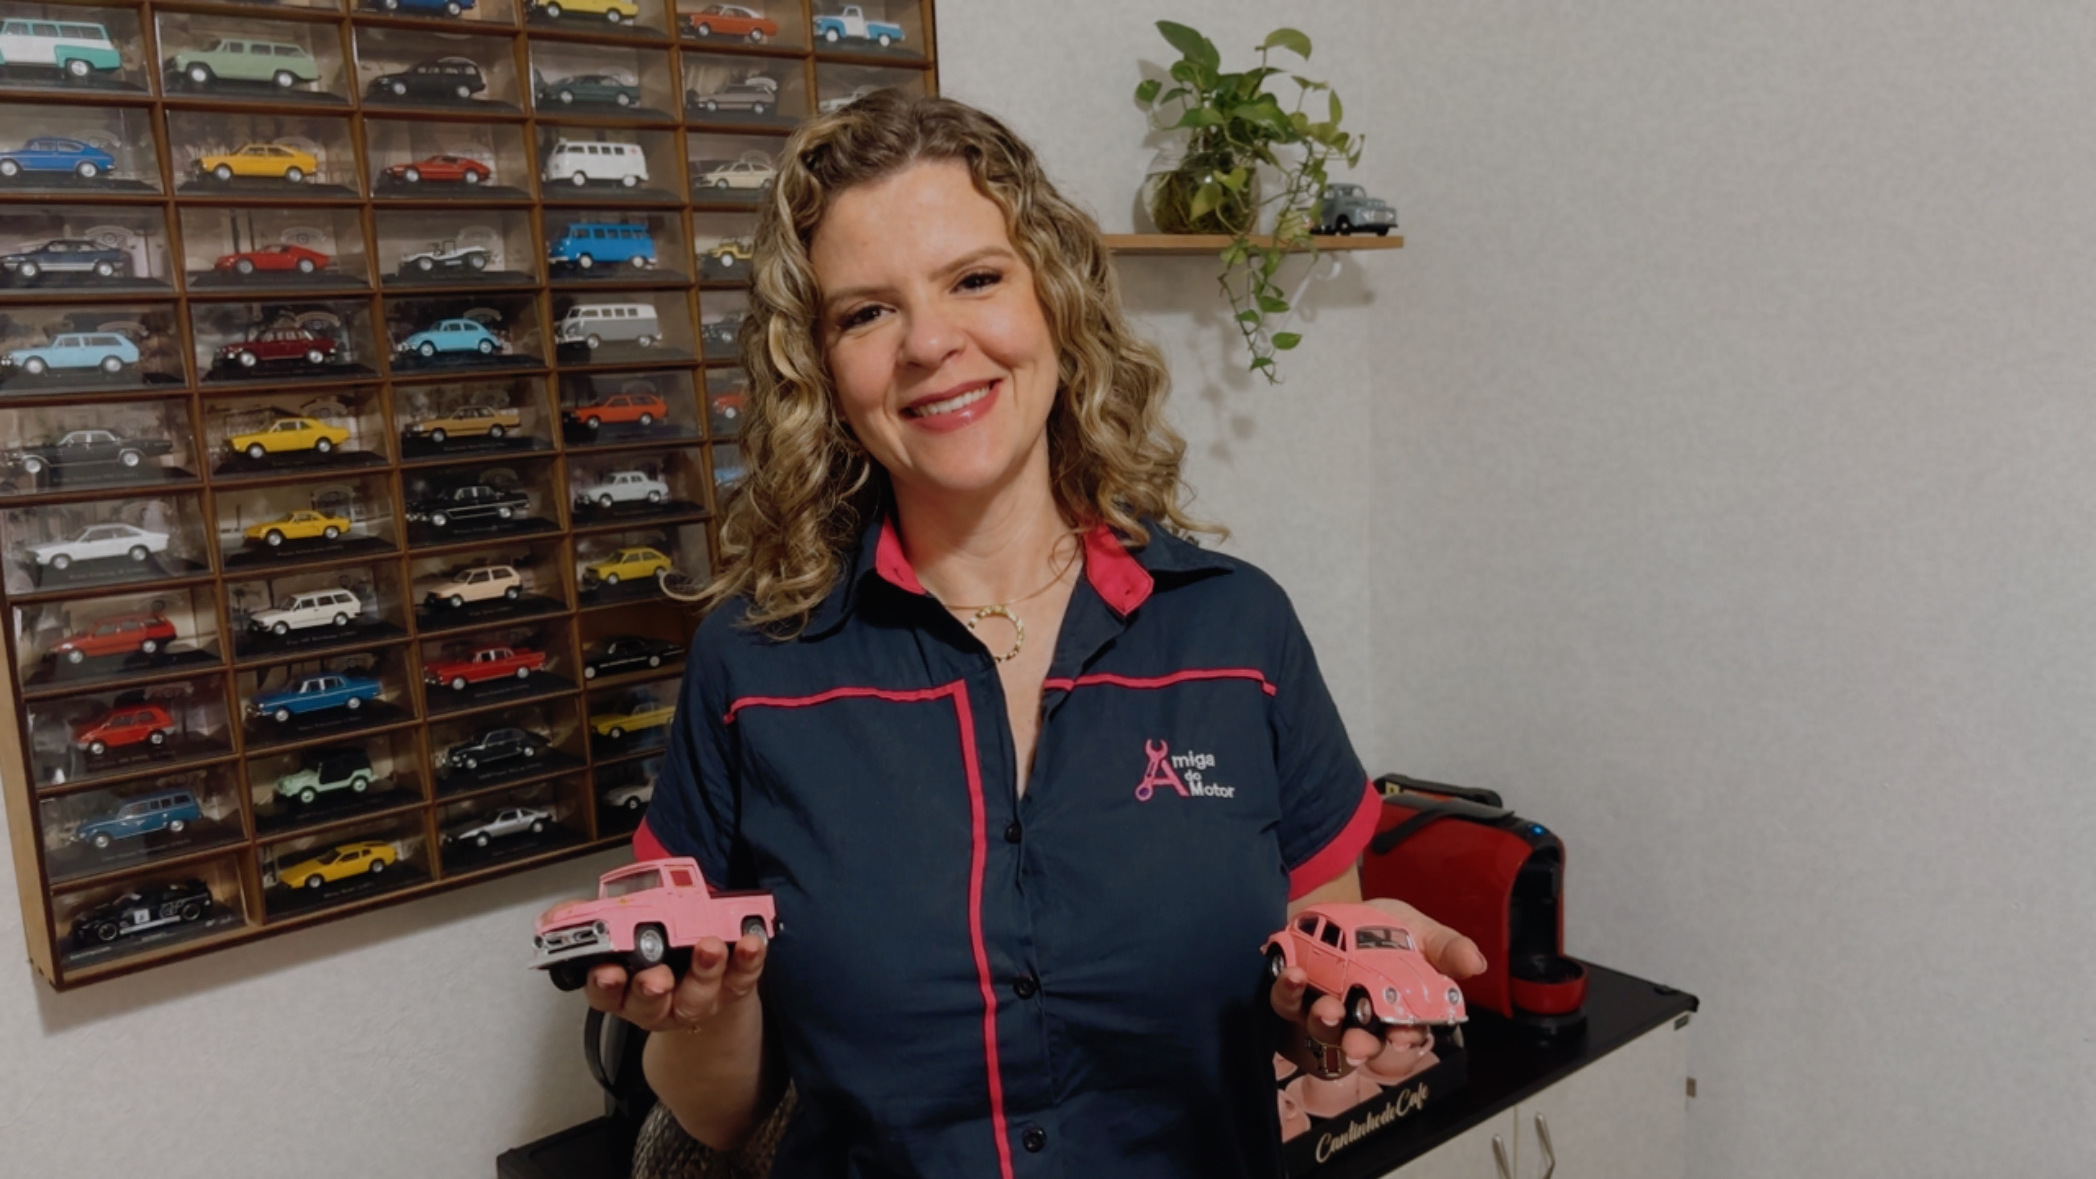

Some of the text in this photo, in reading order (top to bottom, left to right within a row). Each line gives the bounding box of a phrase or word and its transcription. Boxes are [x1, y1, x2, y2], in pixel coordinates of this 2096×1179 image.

[1184, 769, 1202, 781] do
[1189, 781, 1235, 798] Motor
[1315, 1111, 1381, 1164] Cantinho
